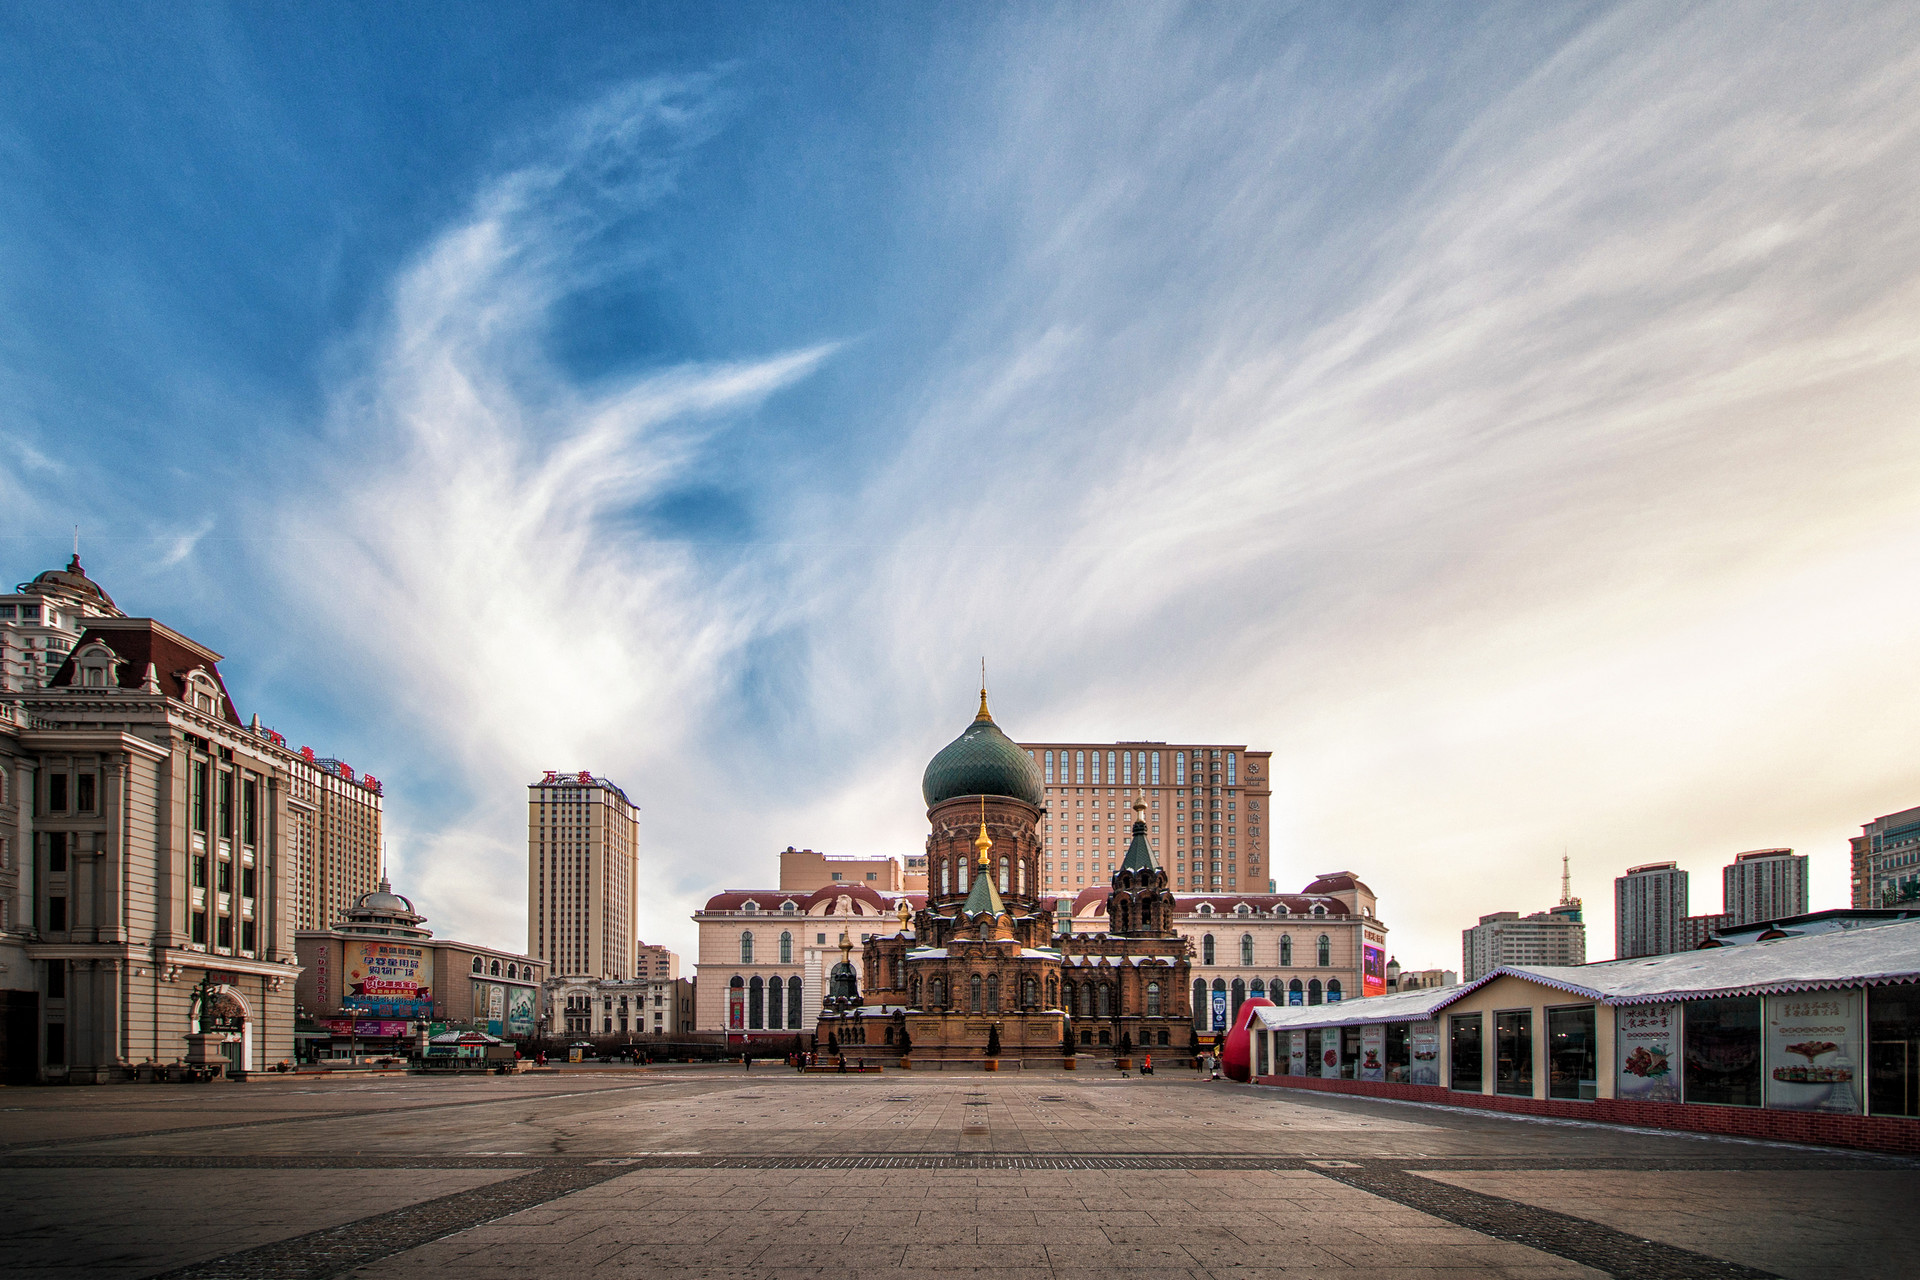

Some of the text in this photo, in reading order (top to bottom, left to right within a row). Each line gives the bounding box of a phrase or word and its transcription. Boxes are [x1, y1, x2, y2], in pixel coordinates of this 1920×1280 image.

[543, 770, 592, 785] 万泰
[1248, 800, 1261, 877] 曼哈顿大酒店
[363, 957, 419, 968] 孕婴童用品
[368, 966, 415, 977] 购物广场
